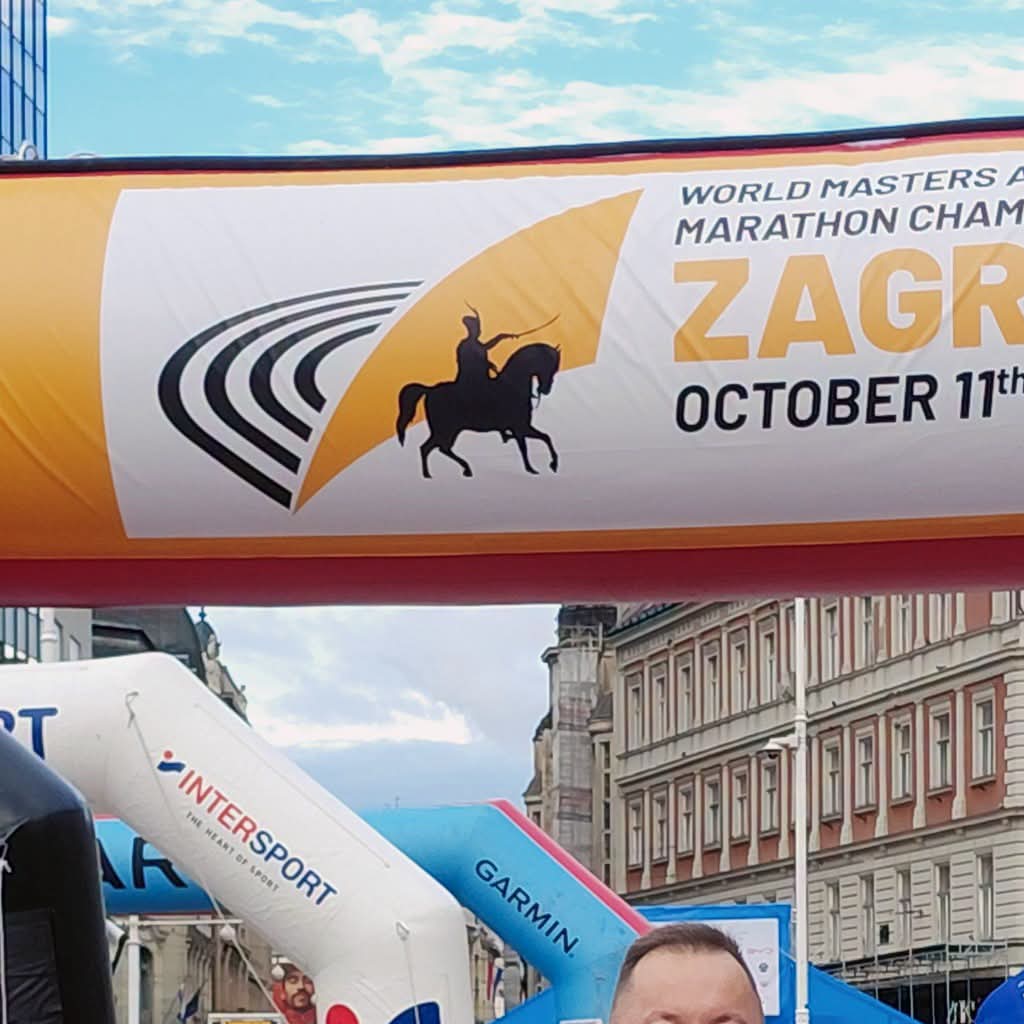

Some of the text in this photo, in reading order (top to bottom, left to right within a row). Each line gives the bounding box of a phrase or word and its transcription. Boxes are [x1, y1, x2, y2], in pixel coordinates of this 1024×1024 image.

[681, 180, 811, 206] WORLD
[820, 166, 997, 199] MASTERS
[674, 206, 899, 246] MARATHON
[675, 373, 938, 433] OCTOBER
[177, 769, 338, 906] INTERSPORT
[186, 811, 280, 893] THE HEART OF SPORT
[475, 858, 580, 955] GARMIN
